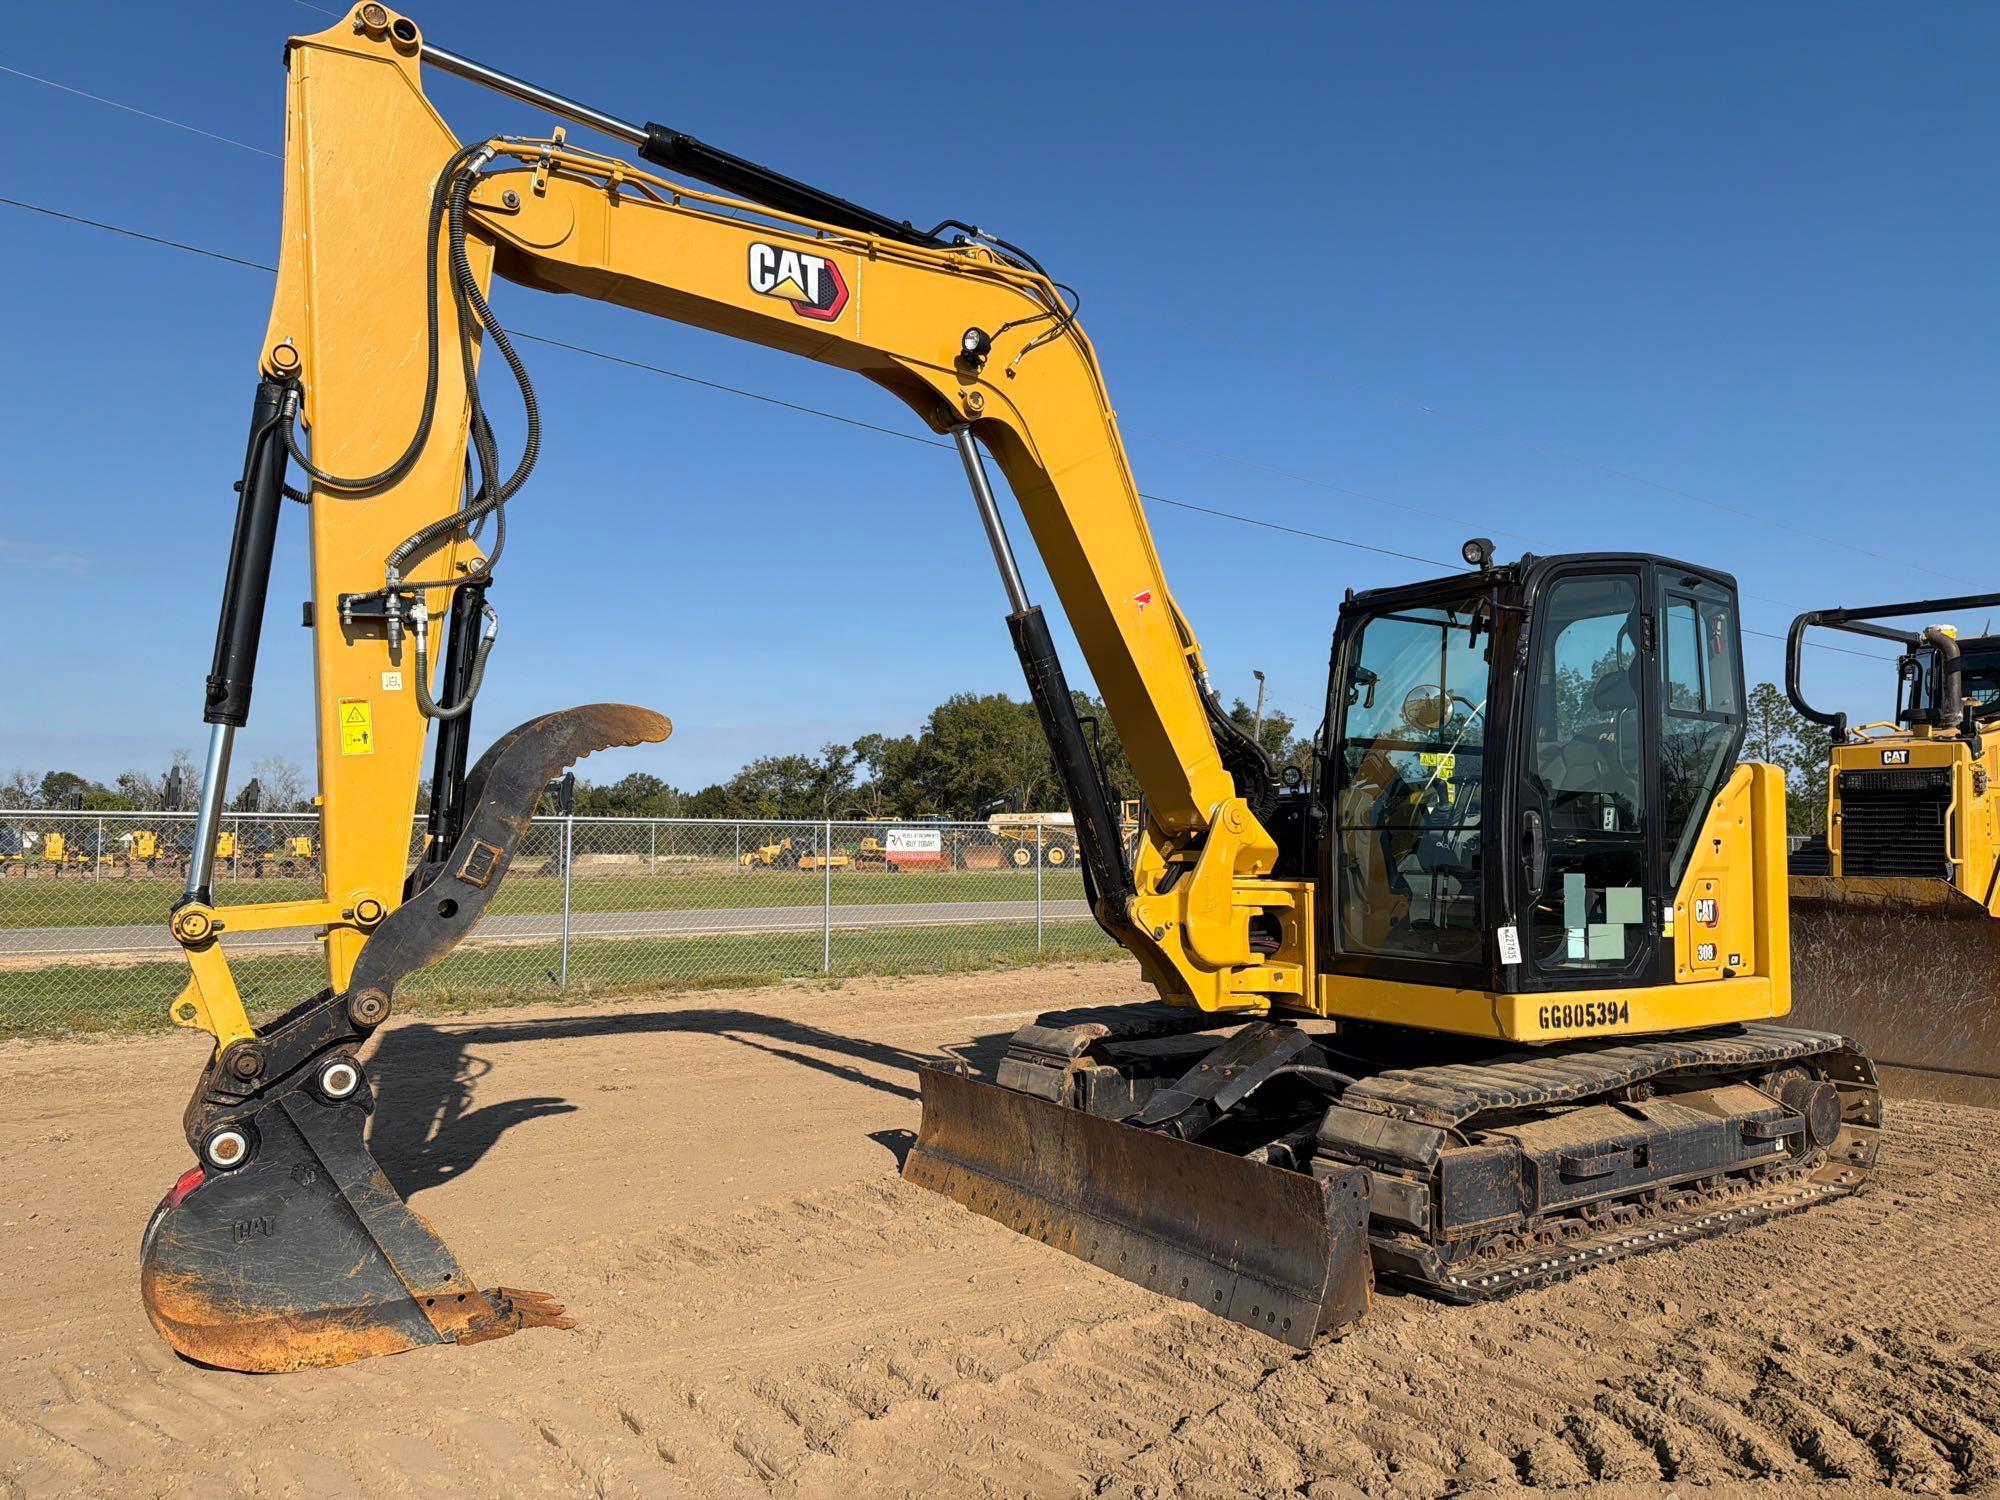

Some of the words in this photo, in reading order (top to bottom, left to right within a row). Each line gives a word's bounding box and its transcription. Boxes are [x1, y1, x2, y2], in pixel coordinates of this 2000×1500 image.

[749, 242, 825, 305] CAT
[1883, 751, 1907, 764] CAT
[1695, 899, 1714, 922] CAT
[1698, 944, 1714, 961] 308
[1730, 955, 1740, 965] CR
[1539, 1000, 1629, 1030] GG805394
[234, 1215, 276, 1244] CAT
